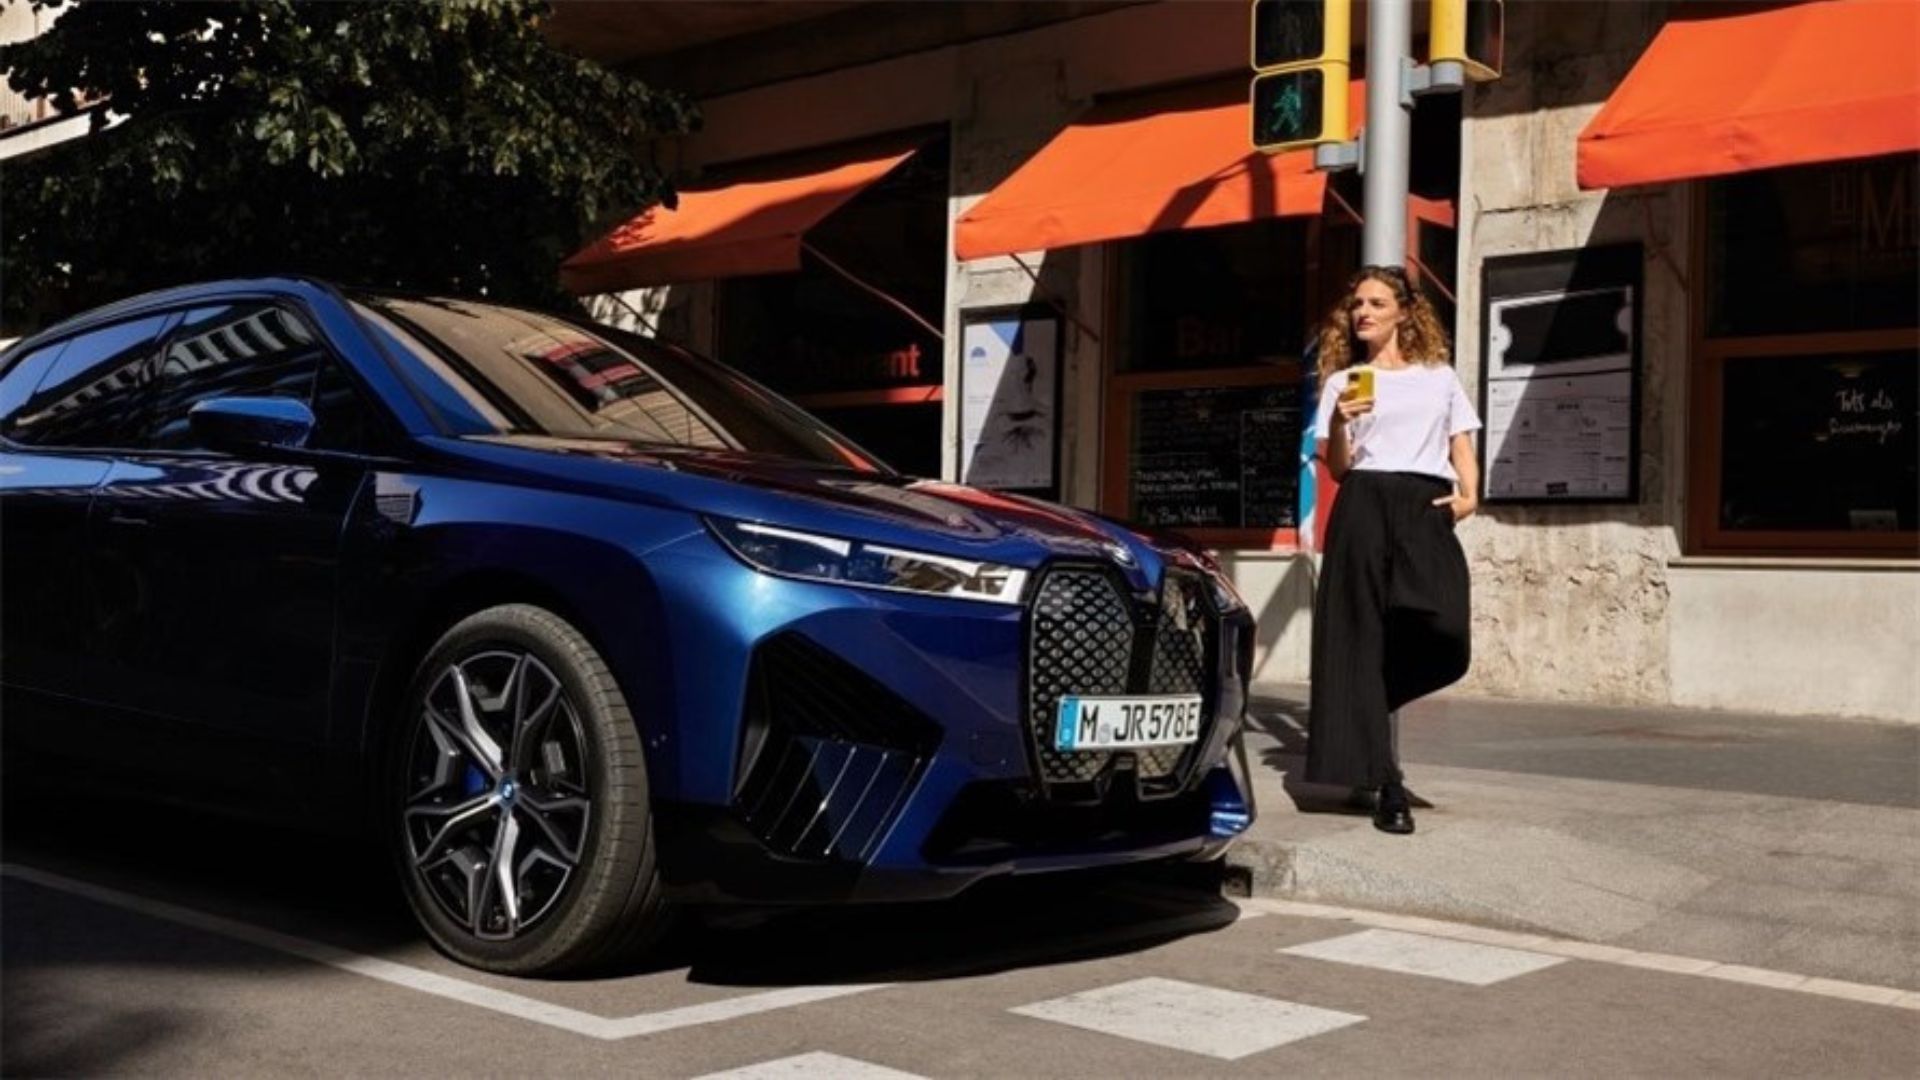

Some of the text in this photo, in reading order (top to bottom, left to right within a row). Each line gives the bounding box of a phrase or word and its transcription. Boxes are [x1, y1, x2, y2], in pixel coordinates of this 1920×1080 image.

[1175, 316, 1244, 357] Bar
[1079, 702, 1198, 742] M JR 578E
